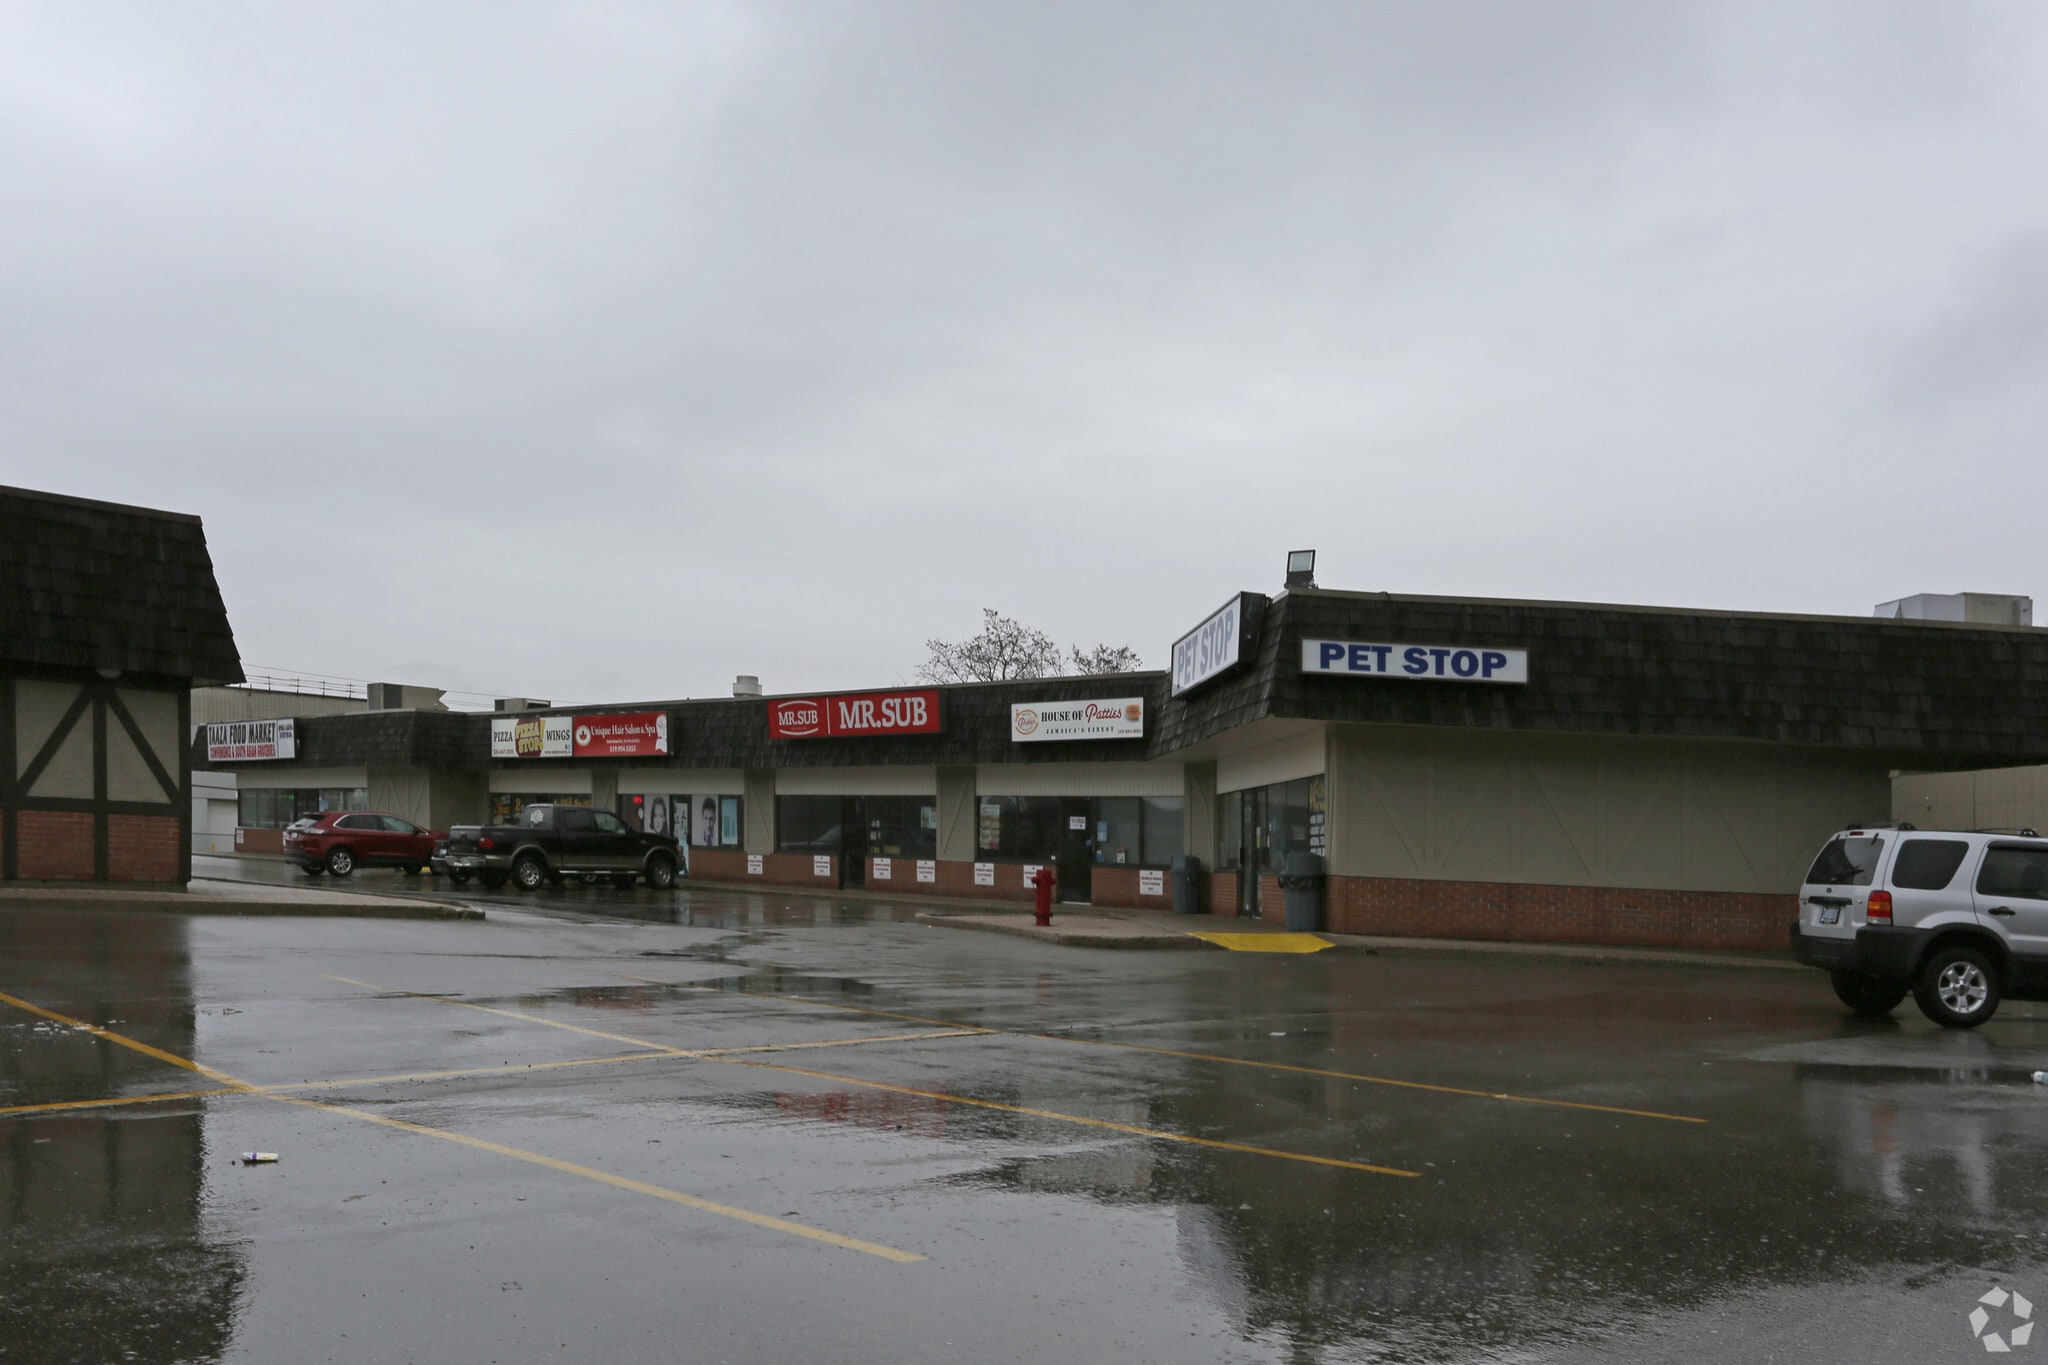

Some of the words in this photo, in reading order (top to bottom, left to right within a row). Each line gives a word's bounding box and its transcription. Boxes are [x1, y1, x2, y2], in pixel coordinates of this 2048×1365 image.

[1177, 634, 1198, 690] PET
[1200, 609, 1234, 676] STOP
[1320, 643, 1392, 672] PET
[1402, 647, 1507, 678] STOP
[778, 710, 818, 726] MR.SUB
[838, 697, 927, 729] MR.SUB
[1041, 711, 1071, 722] HOUSE
[1072, 710, 1084, 721] OF
[1085, 703, 1122, 723] Patties
[208, 726, 228, 745] TAAZA
[230, 724, 246, 744] FOOD
[249, 723, 275, 744] MARKET
[494, 731, 513, 742] PIZZA
[515, 722, 540, 739] PIZZA
[546, 730, 570, 741] WINGS
[590, 725, 611, 739] Unique
[612, 724, 624, 735] Hair
[625, 723, 640, 735] Salon
[645, 723, 656, 738] Spa
[1046, 727, 1085, 735] JAMAICA'S
